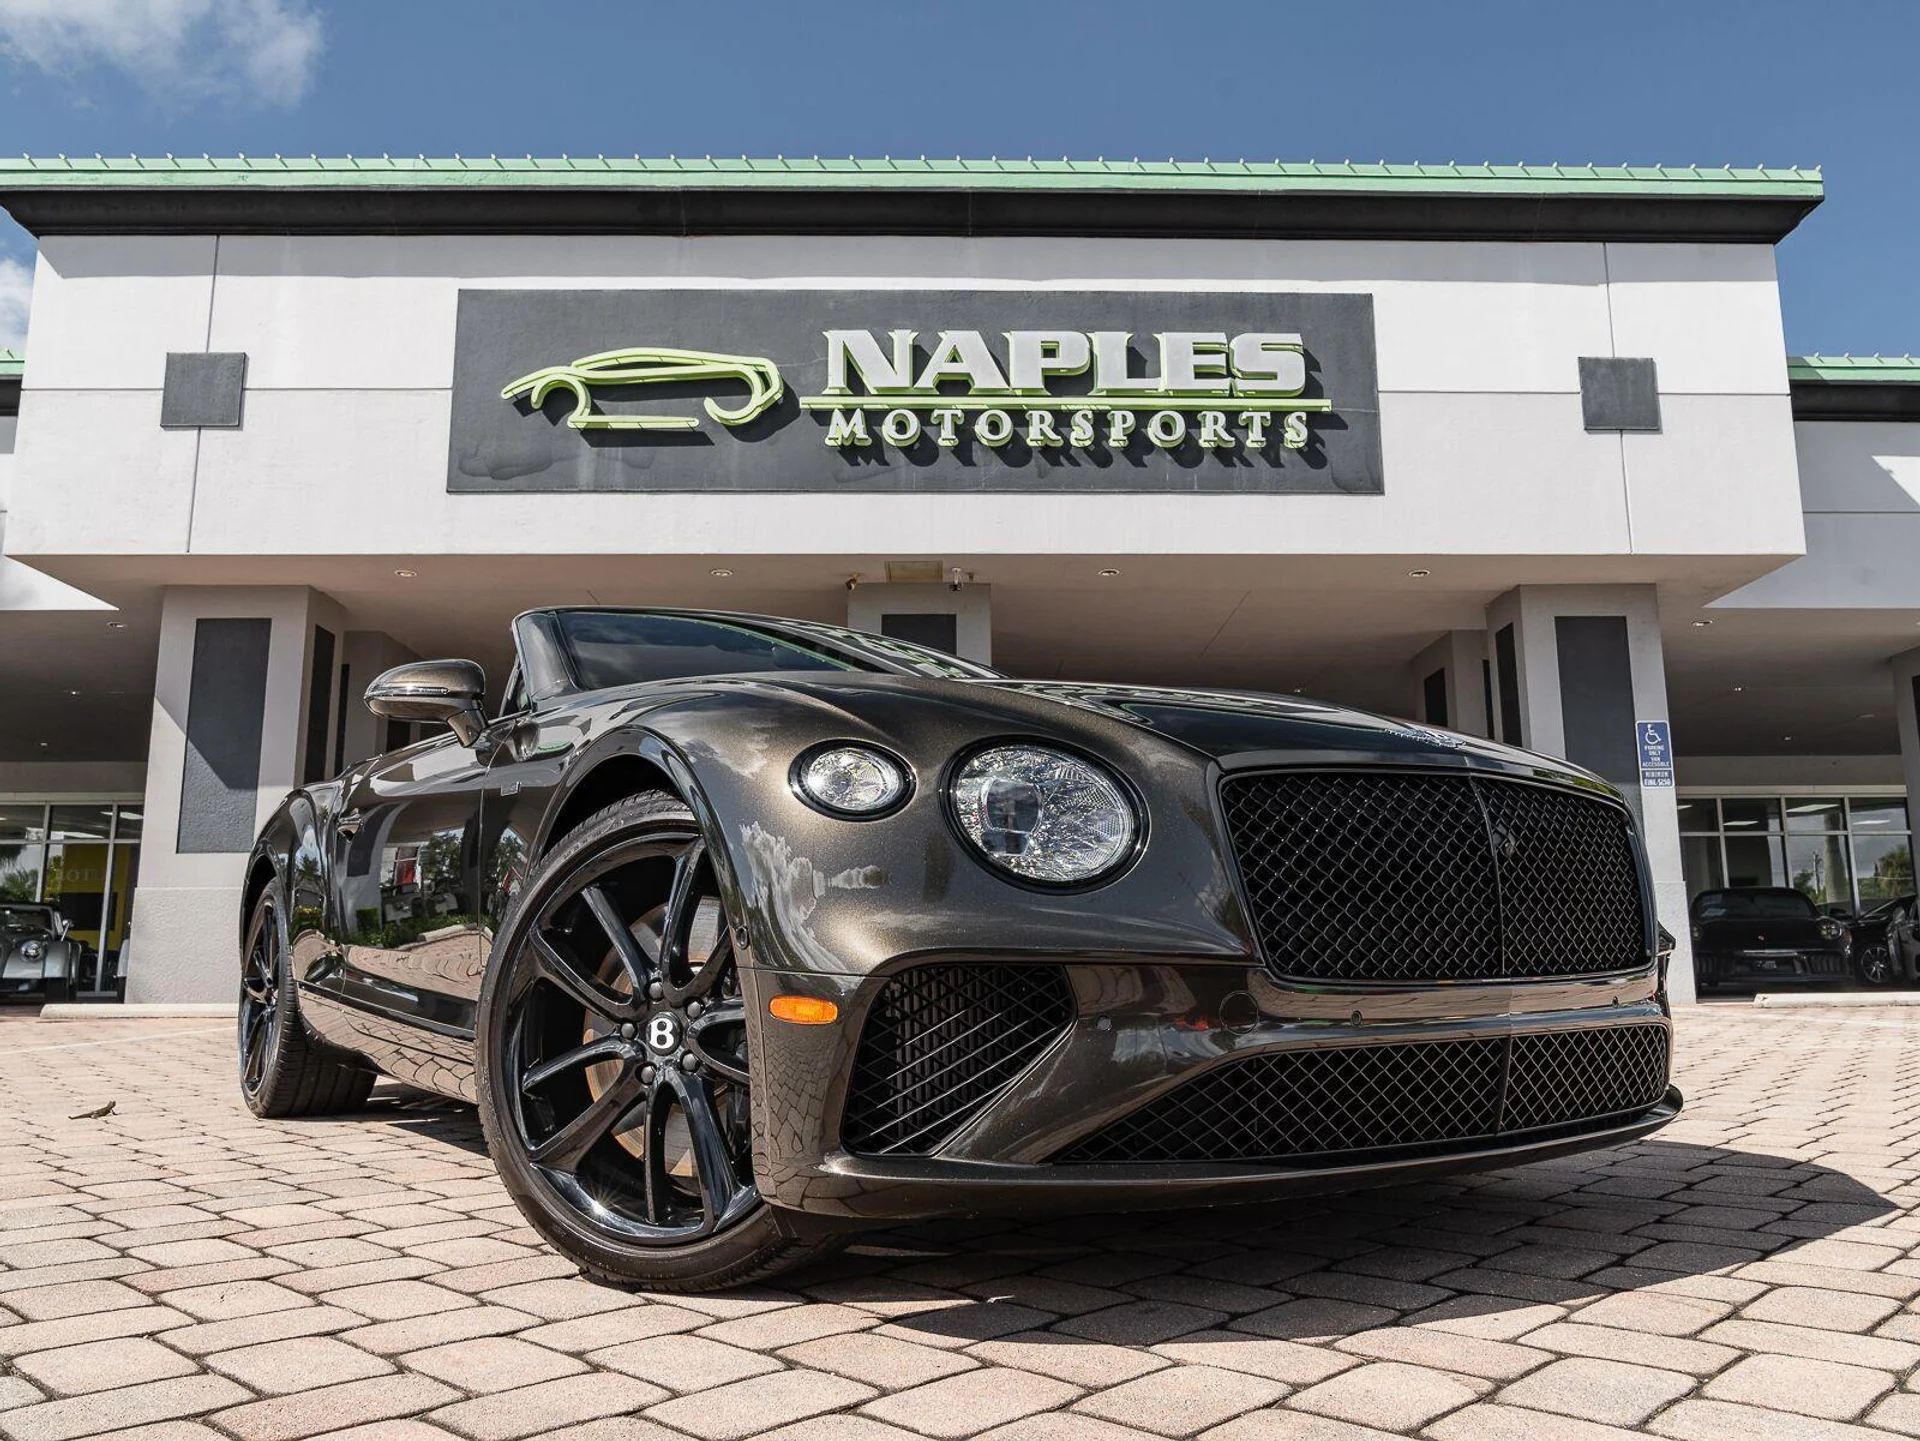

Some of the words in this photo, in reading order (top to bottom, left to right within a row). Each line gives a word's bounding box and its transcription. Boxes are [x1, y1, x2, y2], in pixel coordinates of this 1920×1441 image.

[821, 329, 1309, 396] NAPLES
[825, 408, 1310, 447] MOTORSPORTS
[649, 1018, 674, 1049] B
